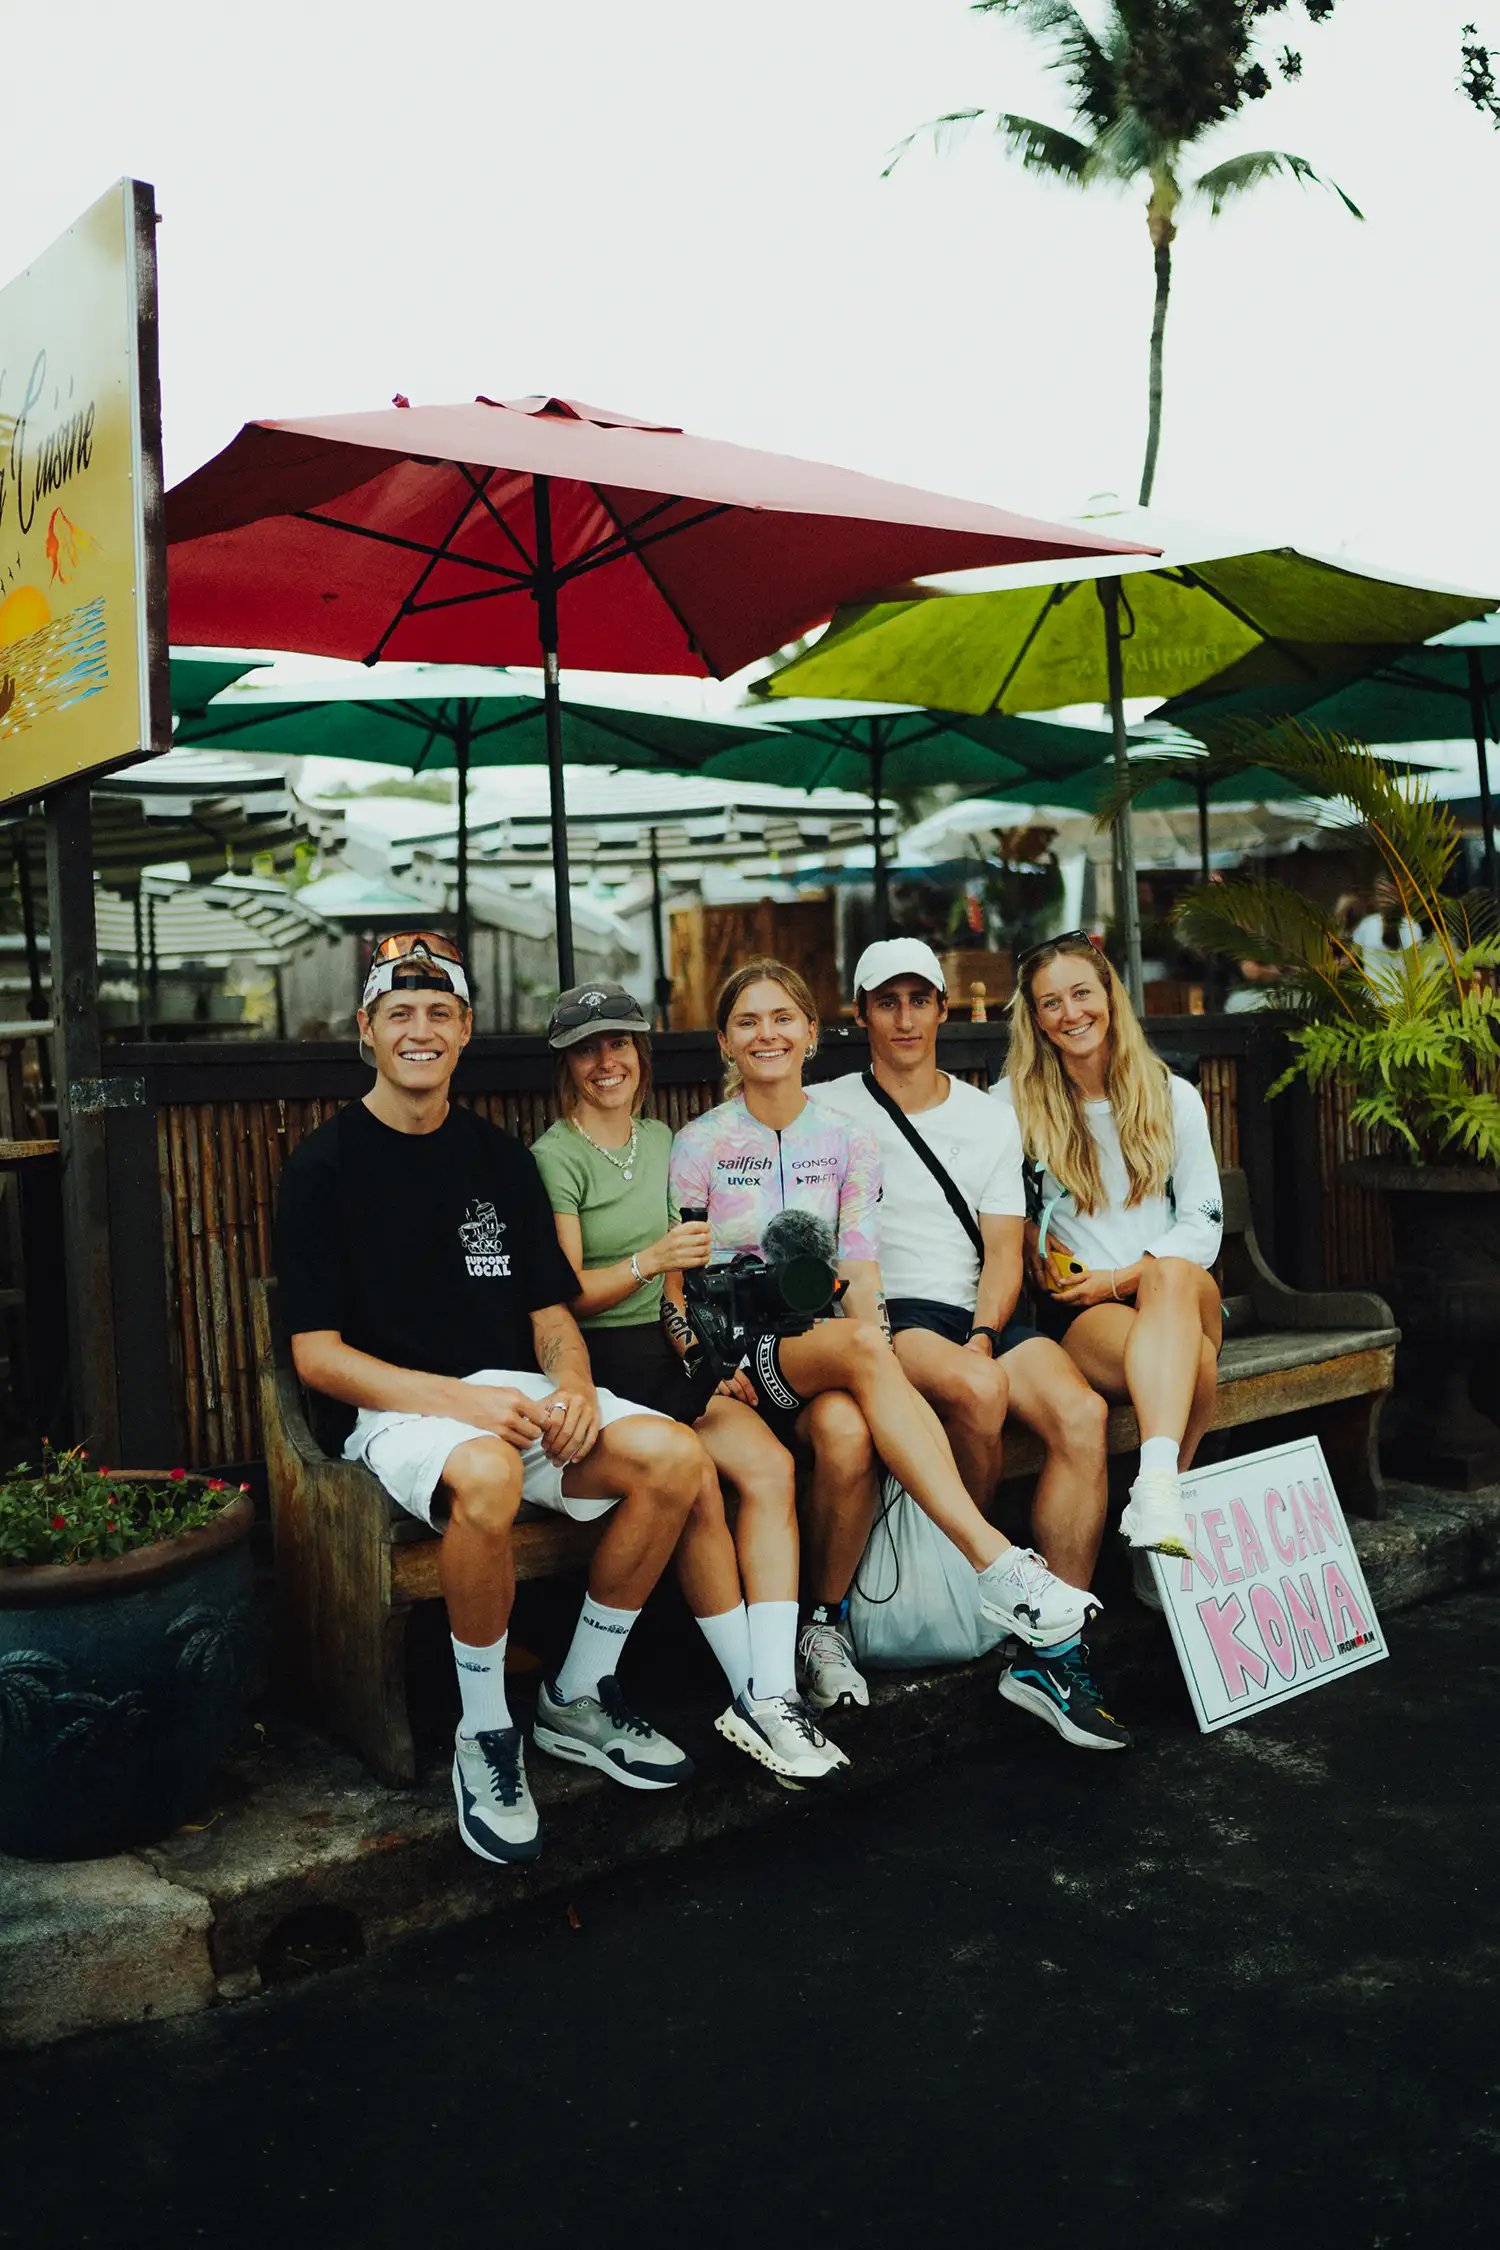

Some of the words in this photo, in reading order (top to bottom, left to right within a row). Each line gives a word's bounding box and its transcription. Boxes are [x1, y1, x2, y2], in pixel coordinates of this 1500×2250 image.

[717, 1157, 772, 1174] sailfish
[792, 1158, 838, 1169] GONSO
[728, 1177, 760, 1186] uvex
[465, 1255, 510, 1265] SUPPORT
[467, 1264, 512, 1277] LOCAL
[761, 1347, 793, 1406] ORTLIEB
[1264, 1477, 1343, 1567] CAN
[1196, 1561, 1369, 1702] KONA
[1337, 1630, 1375, 1655] IRONMAN
